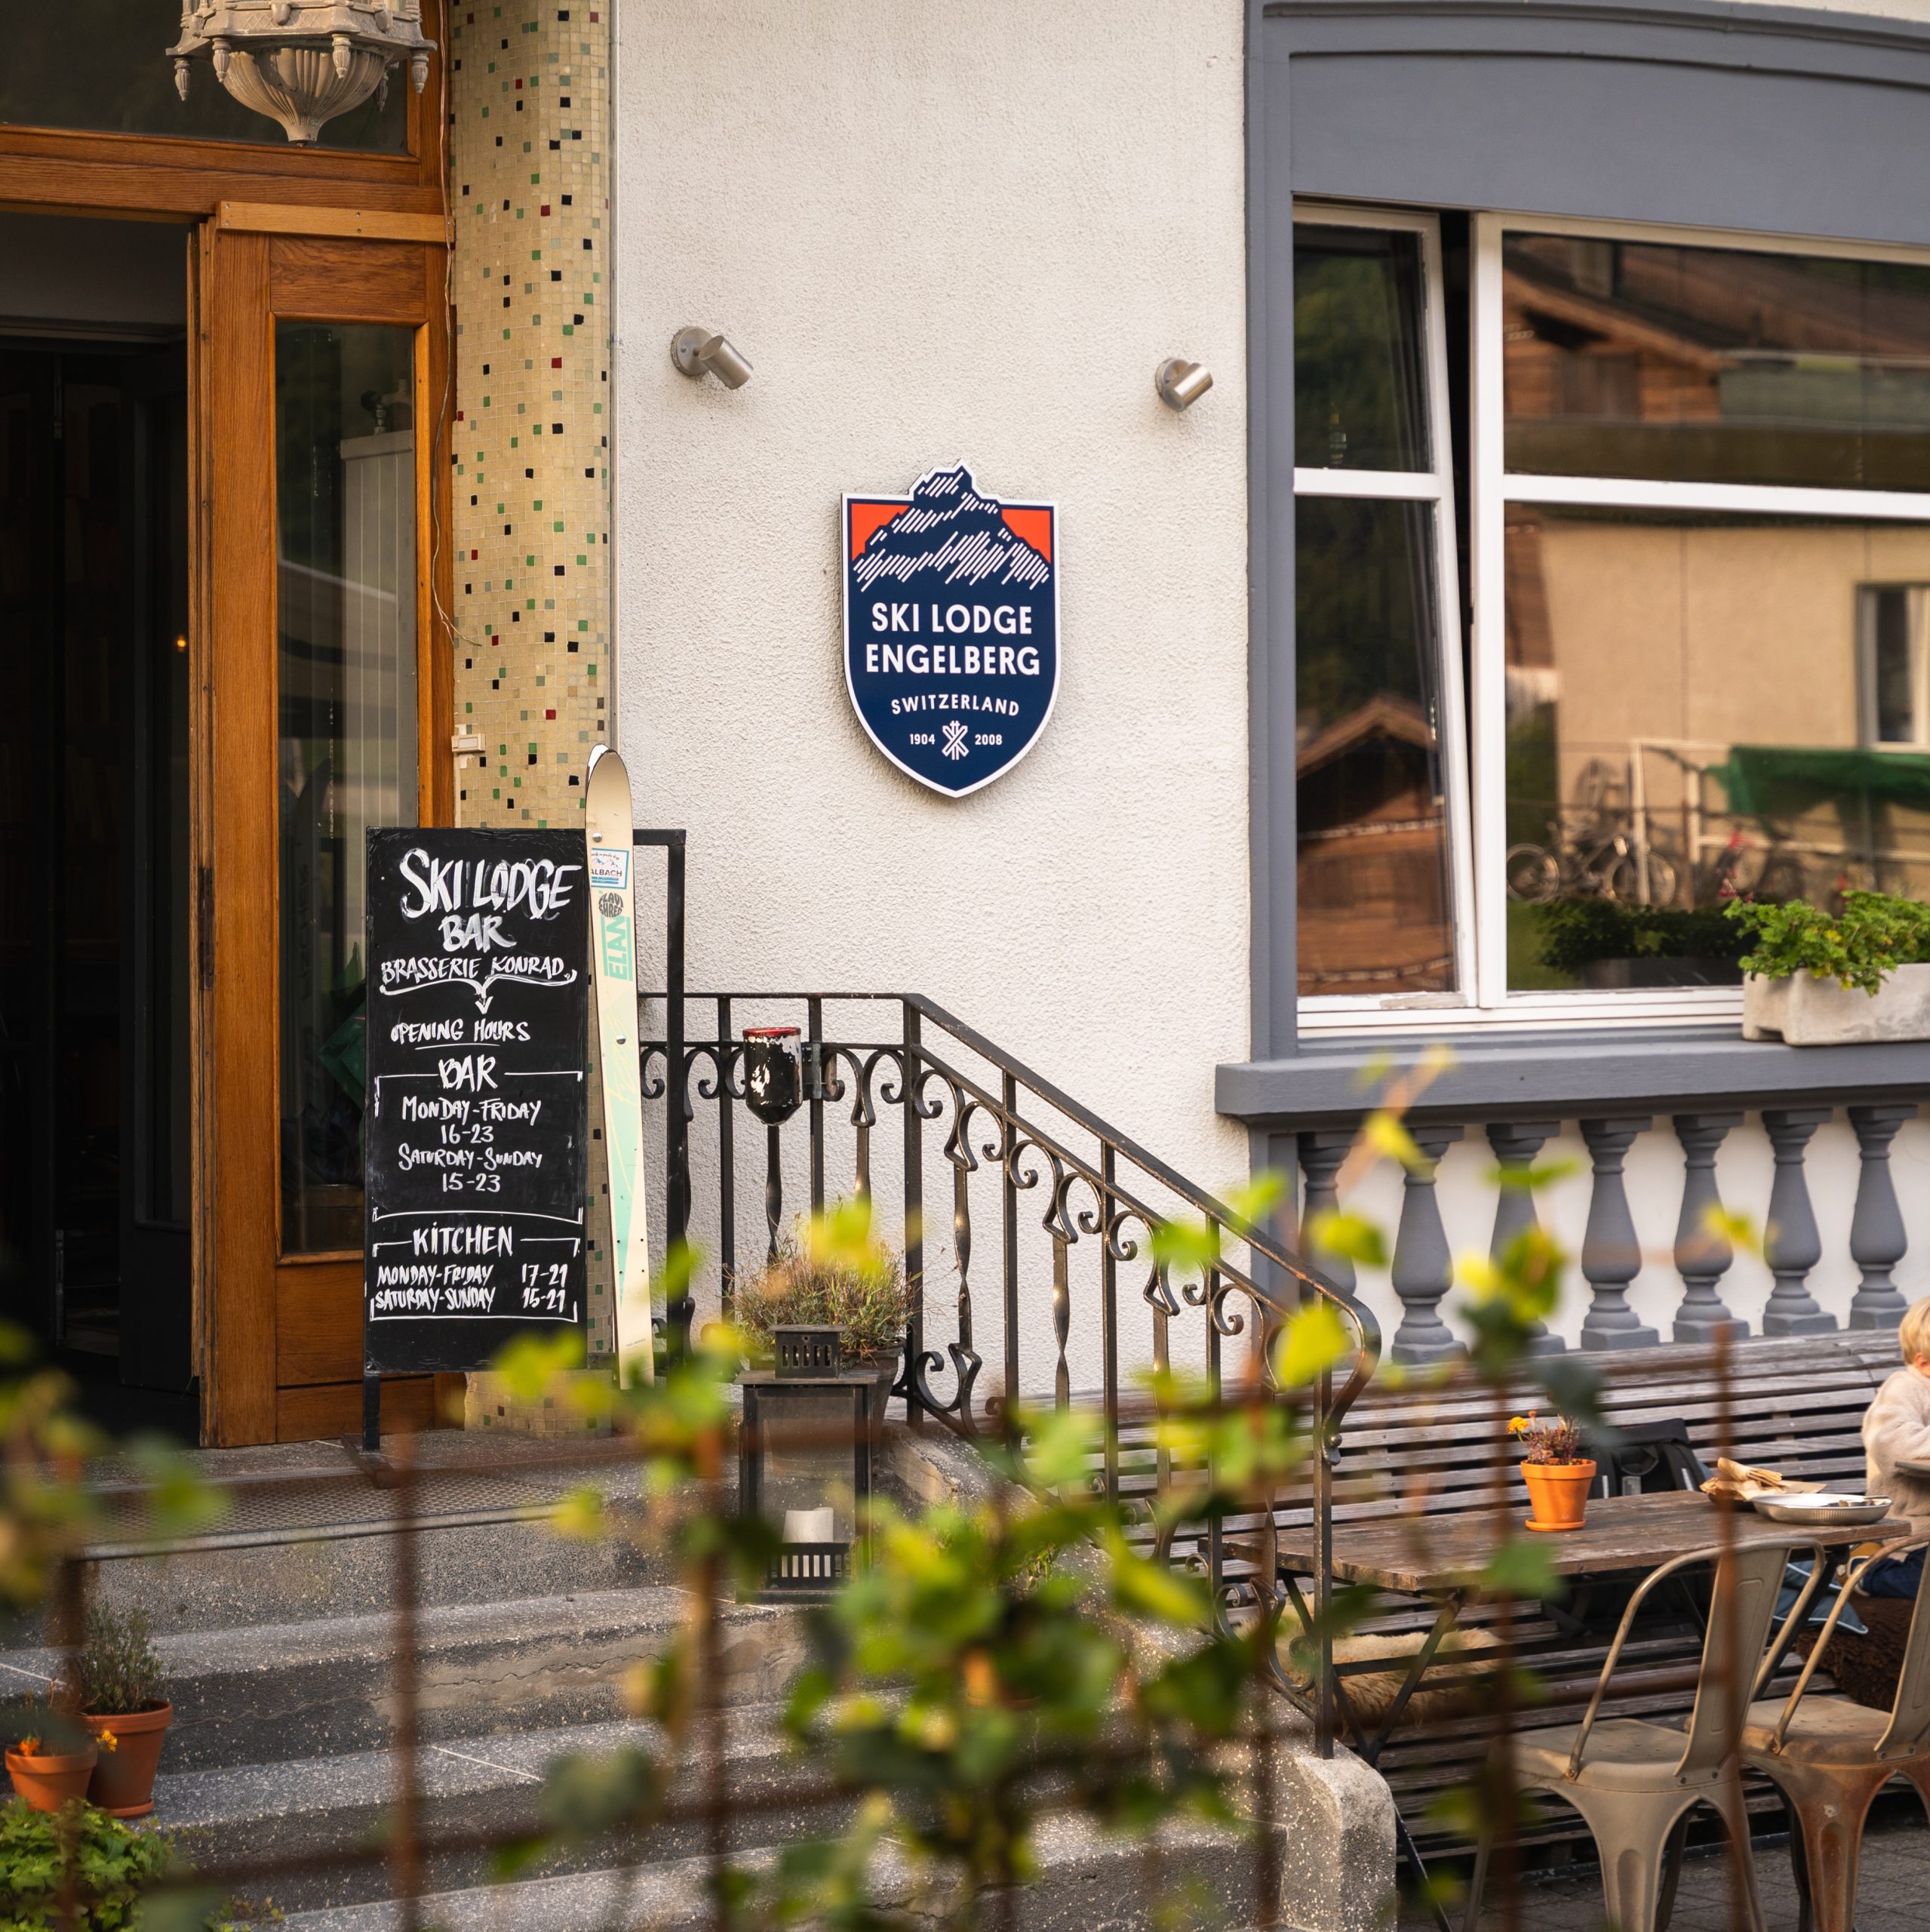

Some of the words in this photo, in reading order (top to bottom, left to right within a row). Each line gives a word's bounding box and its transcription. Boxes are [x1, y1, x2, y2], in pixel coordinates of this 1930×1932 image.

[871, 602, 920, 632] SKI
[932, 604, 1032, 635] LODGE
[866, 644, 1040, 675] ENGELBERG
[890, 694, 1019, 716] SWITZERLAND
[909, 734, 936, 745] 1904
[974, 734, 1003, 746] 2008
[399, 848, 464, 919] SKI
[472, 858, 582, 920] LODGE
[438, 912, 518, 953] BAR
[607, 915, 628, 980] ELAN
[381, 956, 482, 984] BRASSERIE
[490, 956, 564, 980] KONRAD
[390, 1019, 464, 1044] OPENING
[474, 1018, 531, 1042] HOURS
[438, 1054, 498, 1092] BAR
[401, 1096, 542, 1127] MONDAY-FRIDAY
[441, 1123, 494, 1145] 16-23
[398, 1143, 542, 1171] SATURDAY-SUNDAY
[442, 1172, 501, 1193] 15-23
[377, 1264, 494, 1287] MONDAY-FRIDAY
[521, 1263, 568, 1288] 17-21
[375, 1286, 496, 1313] SATURDAY-SUNDAY
